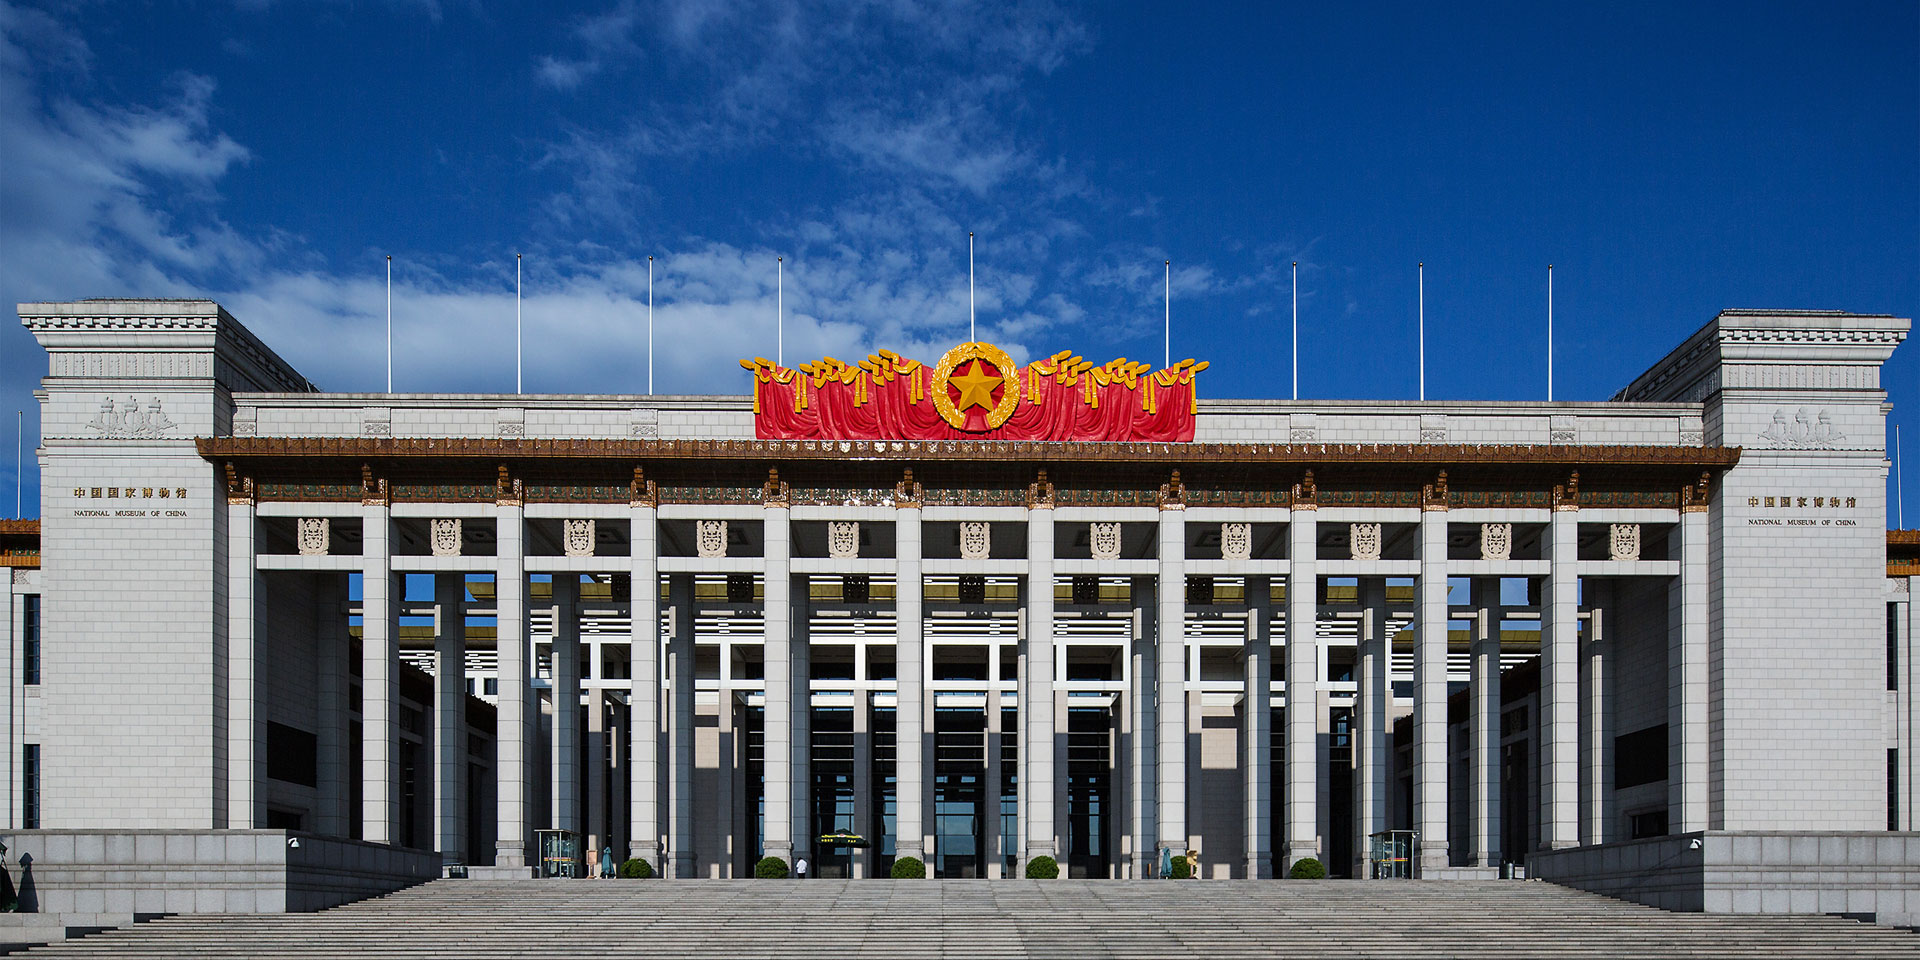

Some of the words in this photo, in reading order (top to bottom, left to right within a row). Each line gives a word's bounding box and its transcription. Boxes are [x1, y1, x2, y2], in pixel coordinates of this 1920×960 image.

[73, 486, 188, 499] 中国国家博物馆
[1747, 495, 1857, 508] 中国国家博物馆
